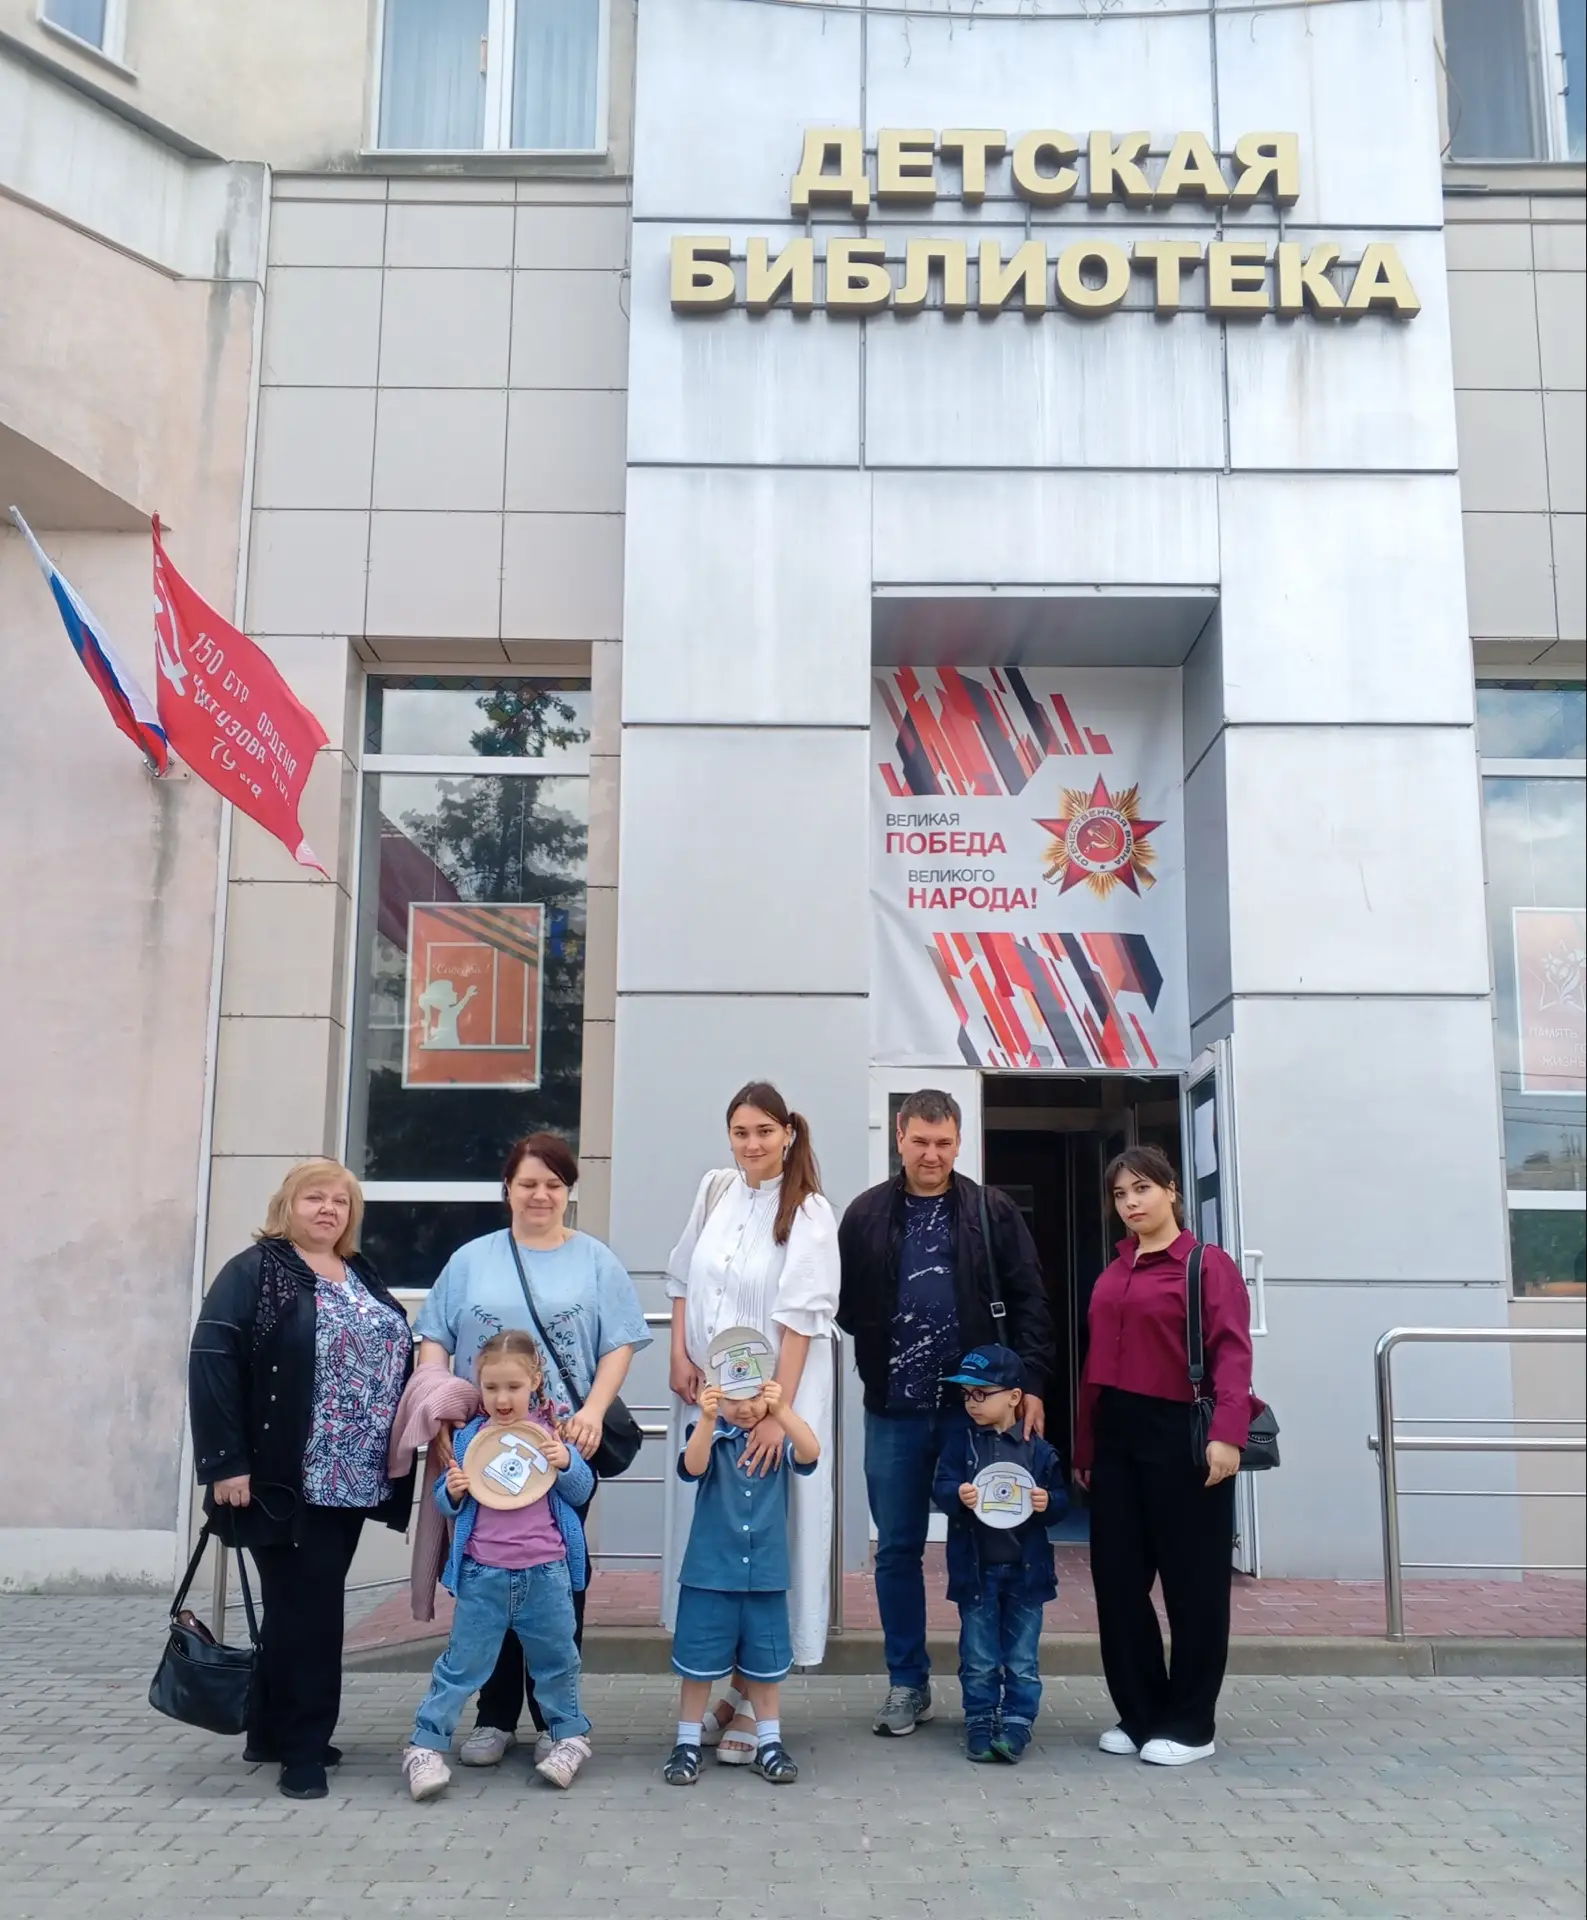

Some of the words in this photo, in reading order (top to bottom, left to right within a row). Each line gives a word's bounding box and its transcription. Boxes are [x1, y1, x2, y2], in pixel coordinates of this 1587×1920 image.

[791, 128, 1300, 218] ДЕТСКАЯ
[670, 235, 1422, 320] БИБЛИОТЕКА
[188, 632, 224, 675] 150
[257, 712, 297, 779] ОРДЕНА
[886, 813, 960, 827] ВЕЛИКАЯ
[886, 832, 1007, 857] ПОБЕДА
[1068, 810, 1127, 866] ОТЕЧЕСТВЕННАЯ
[1114, 830, 1131, 865] ВОЙНА
[908, 869, 995, 883] ВЕЛИКОГО
[908, 887, 1037, 912] НАРОДА!
[1529, 1027, 1578, 1039] ПАМЯТЬ
